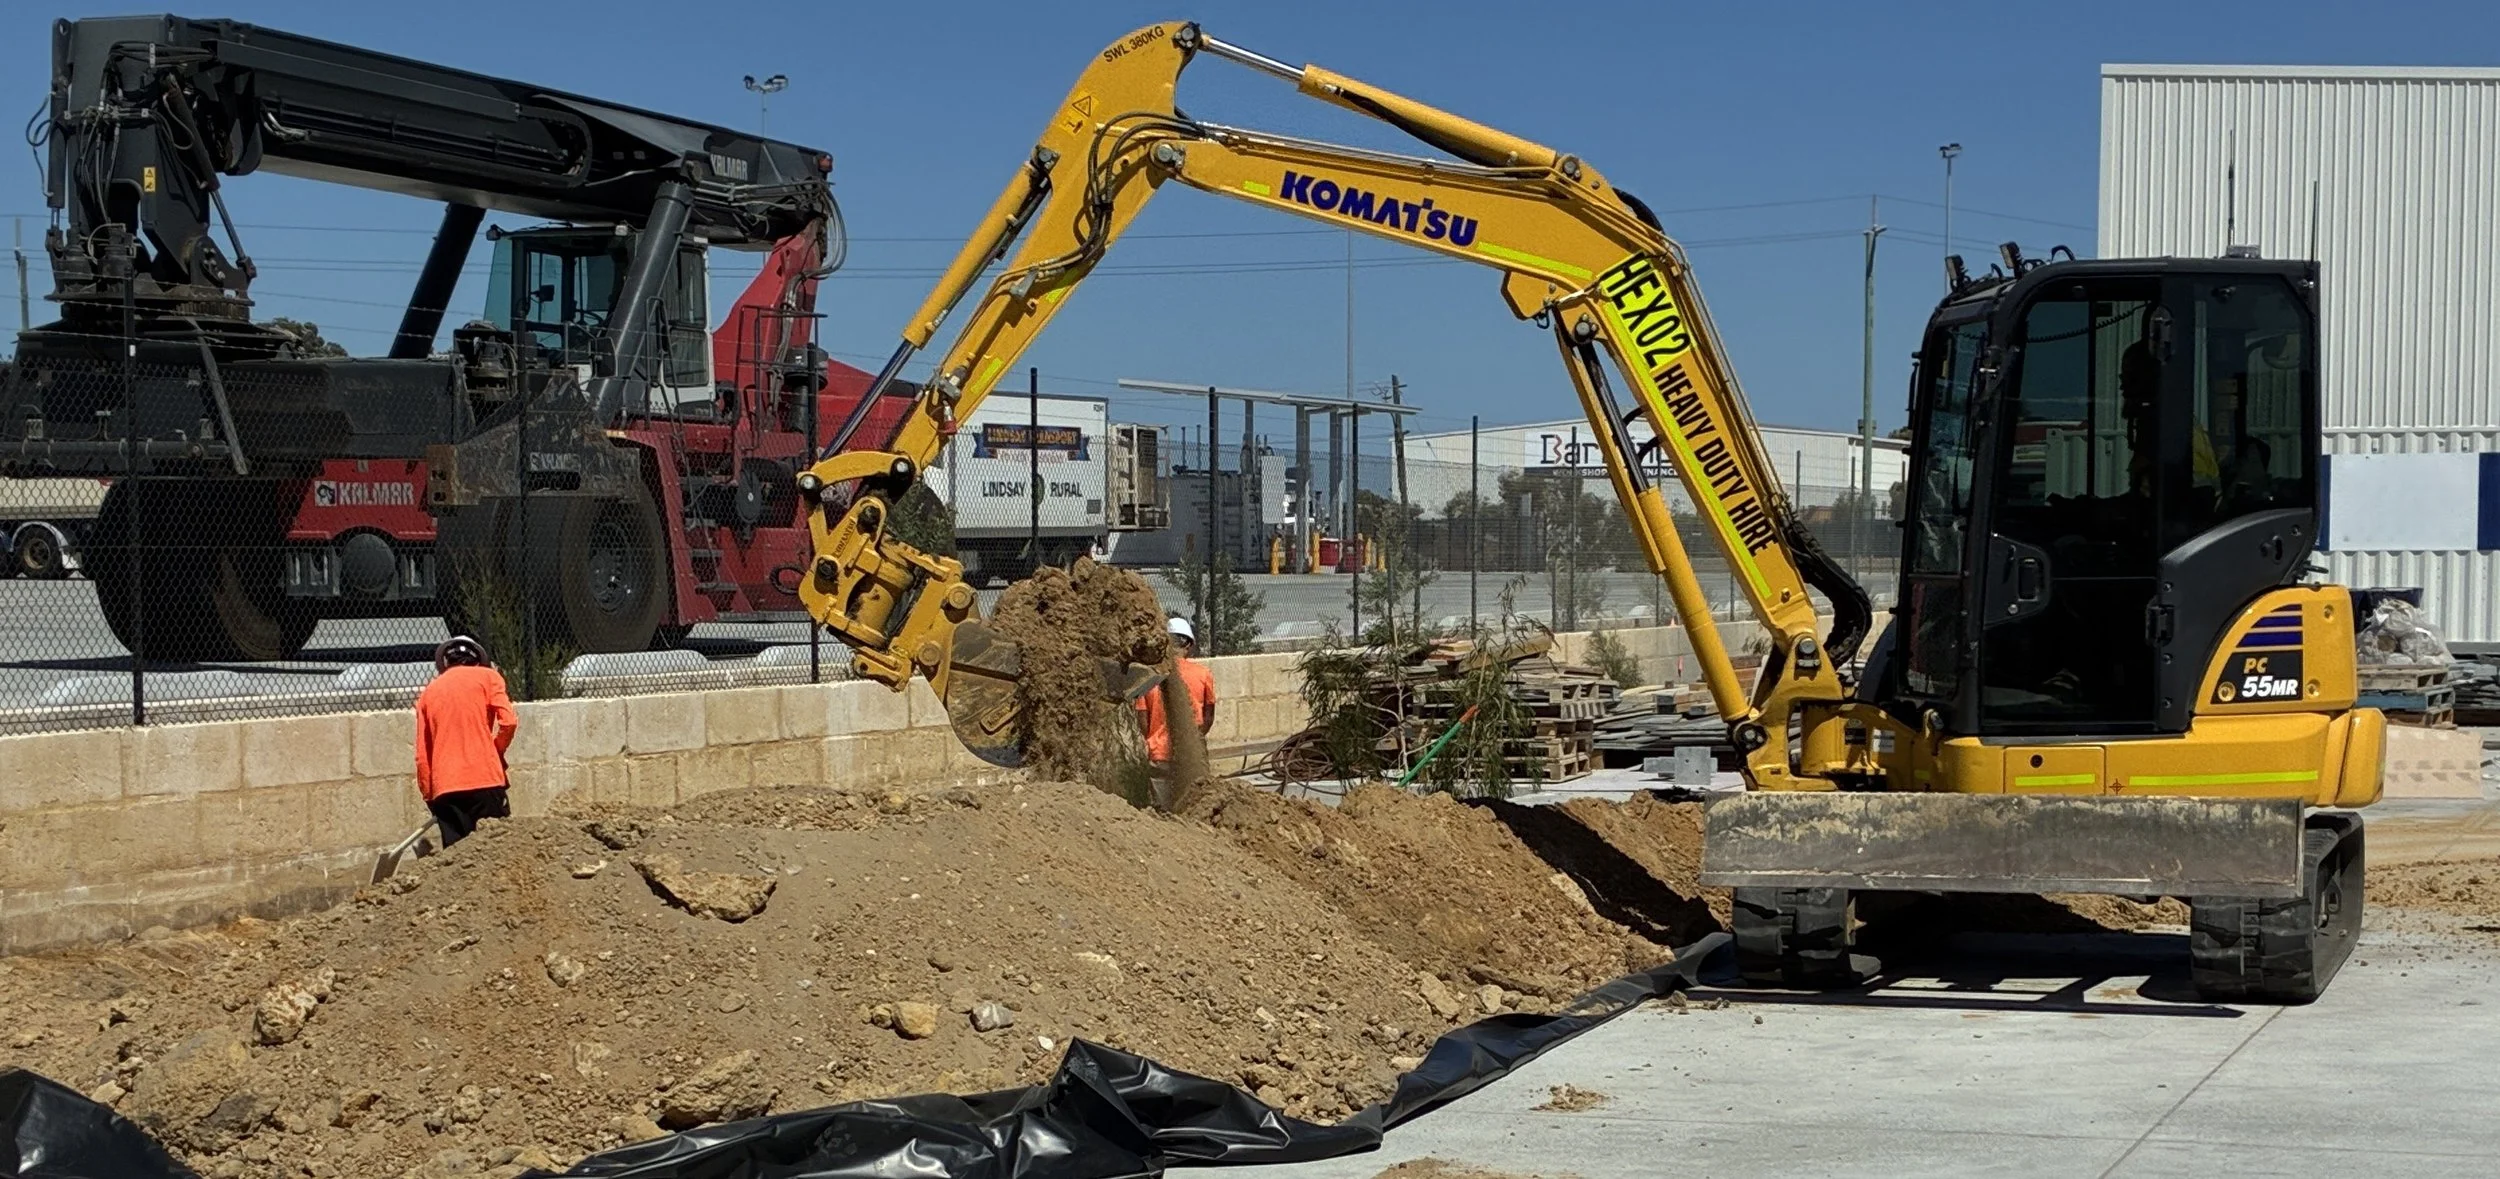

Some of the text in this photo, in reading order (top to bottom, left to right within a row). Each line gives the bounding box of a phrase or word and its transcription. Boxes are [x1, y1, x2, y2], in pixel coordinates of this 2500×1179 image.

[1103, 26, 1165, 62] SWL 380KG
[1280, 171, 1478, 246] KOMATSU
[1600, 251, 1691, 369] HEX02
[1654, 363, 1716, 440] HEAVY
[1694, 439, 1749, 502] DUTY
[1728, 496, 1779, 557] HIRE
[340, 482, 415, 505] KALMAR
[982, 481, 1083, 497] LINDSAY RURAL
[2243, 657, 2268, 674] PC
[2241, 676, 2298, 697] 55MR
